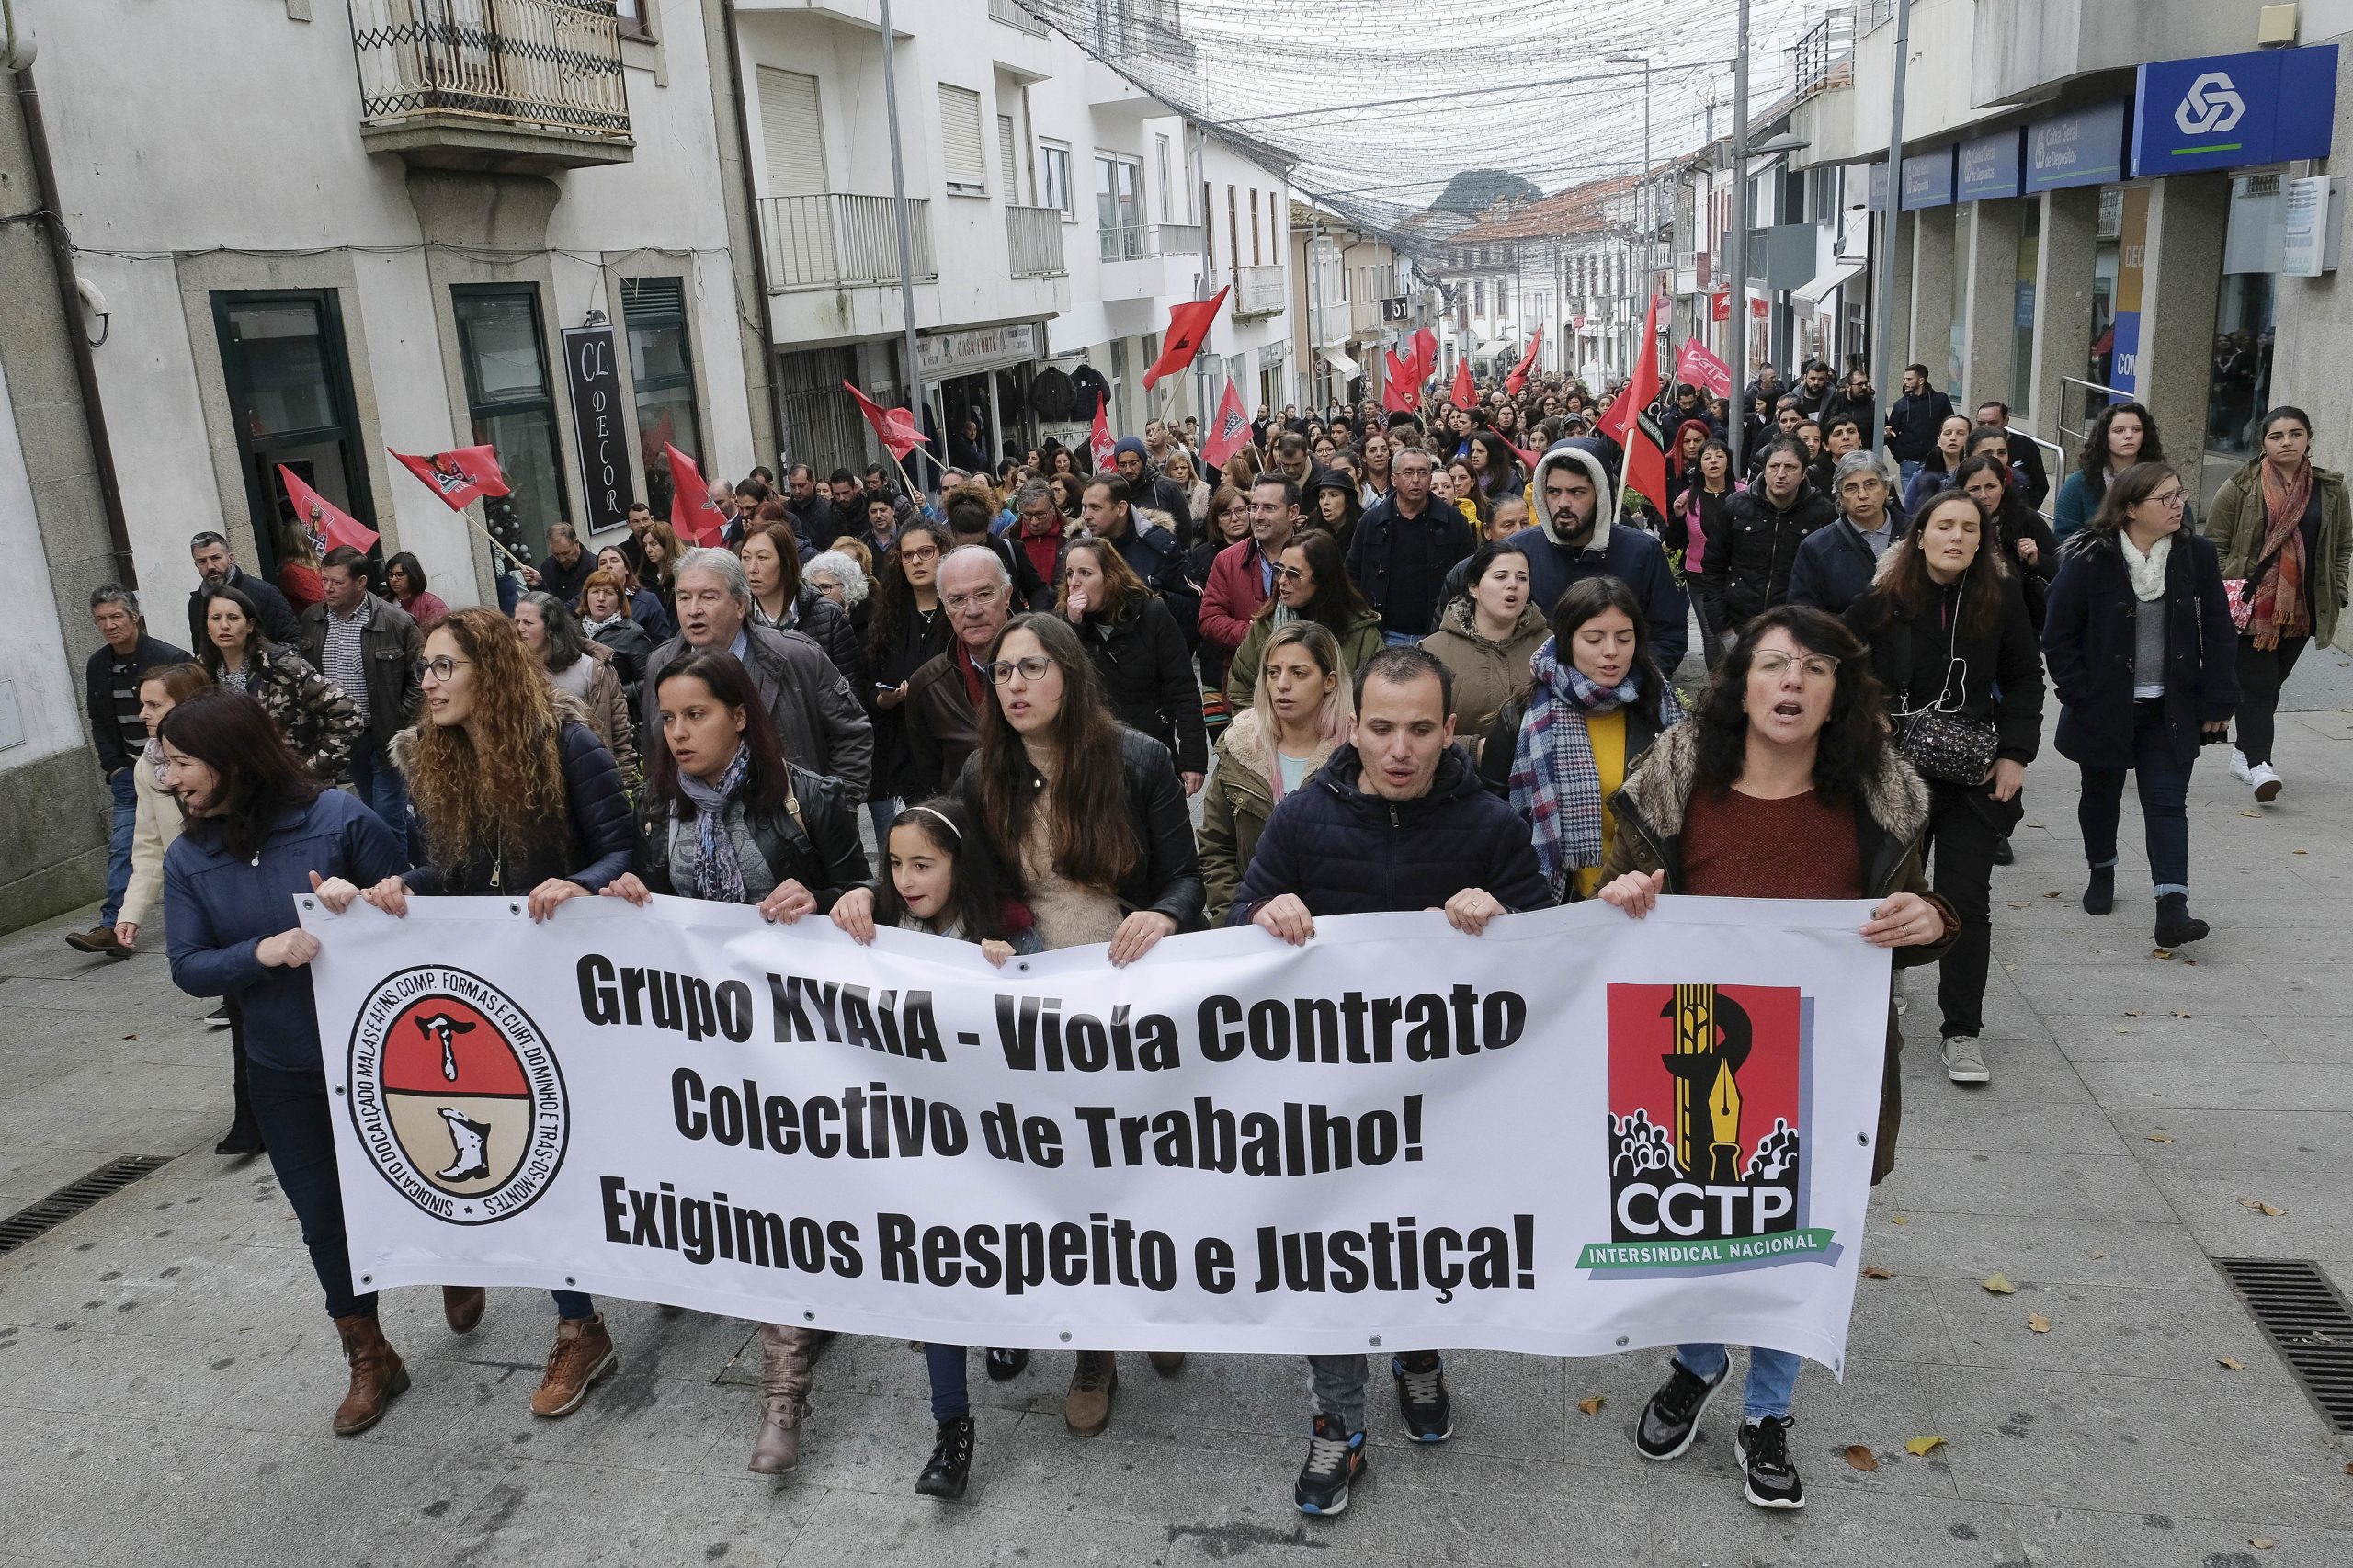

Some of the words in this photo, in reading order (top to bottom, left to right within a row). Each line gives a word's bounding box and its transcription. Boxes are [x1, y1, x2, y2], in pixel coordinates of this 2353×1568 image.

[581, 340, 609, 382] CL
[958, 338, 975, 358] CASA
[1688, 350, 1730, 381] CGTP
[592, 391, 621, 514] DECOR
[395, 972, 438, 998] COMP.
[442, 972, 497, 1011] FORMAS
[503, 1013, 535, 1050] CURT.
[577, 954, 753, 1044] Grupo
[767, 972, 948, 1063] KYAIA
[995, 994, 1180, 1074] Viola
[1198, 984, 1526, 1064] Contrato
[356, 1028, 380, 1078] MALAS
[672, 1068, 968, 1159] Colectivo
[980, 1102, 1063, 1169] de
[1075, 1094, 1423, 1177] Trabalho!
[388, 1162, 453, 1217] SINDICATO
[1617, 1182, 1793, 1236] CGTP
[600, 1176, 864, 1278] Exigimos
[877, 1213, 1177, 1296] Respeito
[1195, 1237, 1236, 1295] e
[1255, 1215, 1534, 1305] Justiça!
[1588, 1247, 1722, 1264] INTERSINDICAL
[1729, 1233, 1818, 1259] NACIONAL
